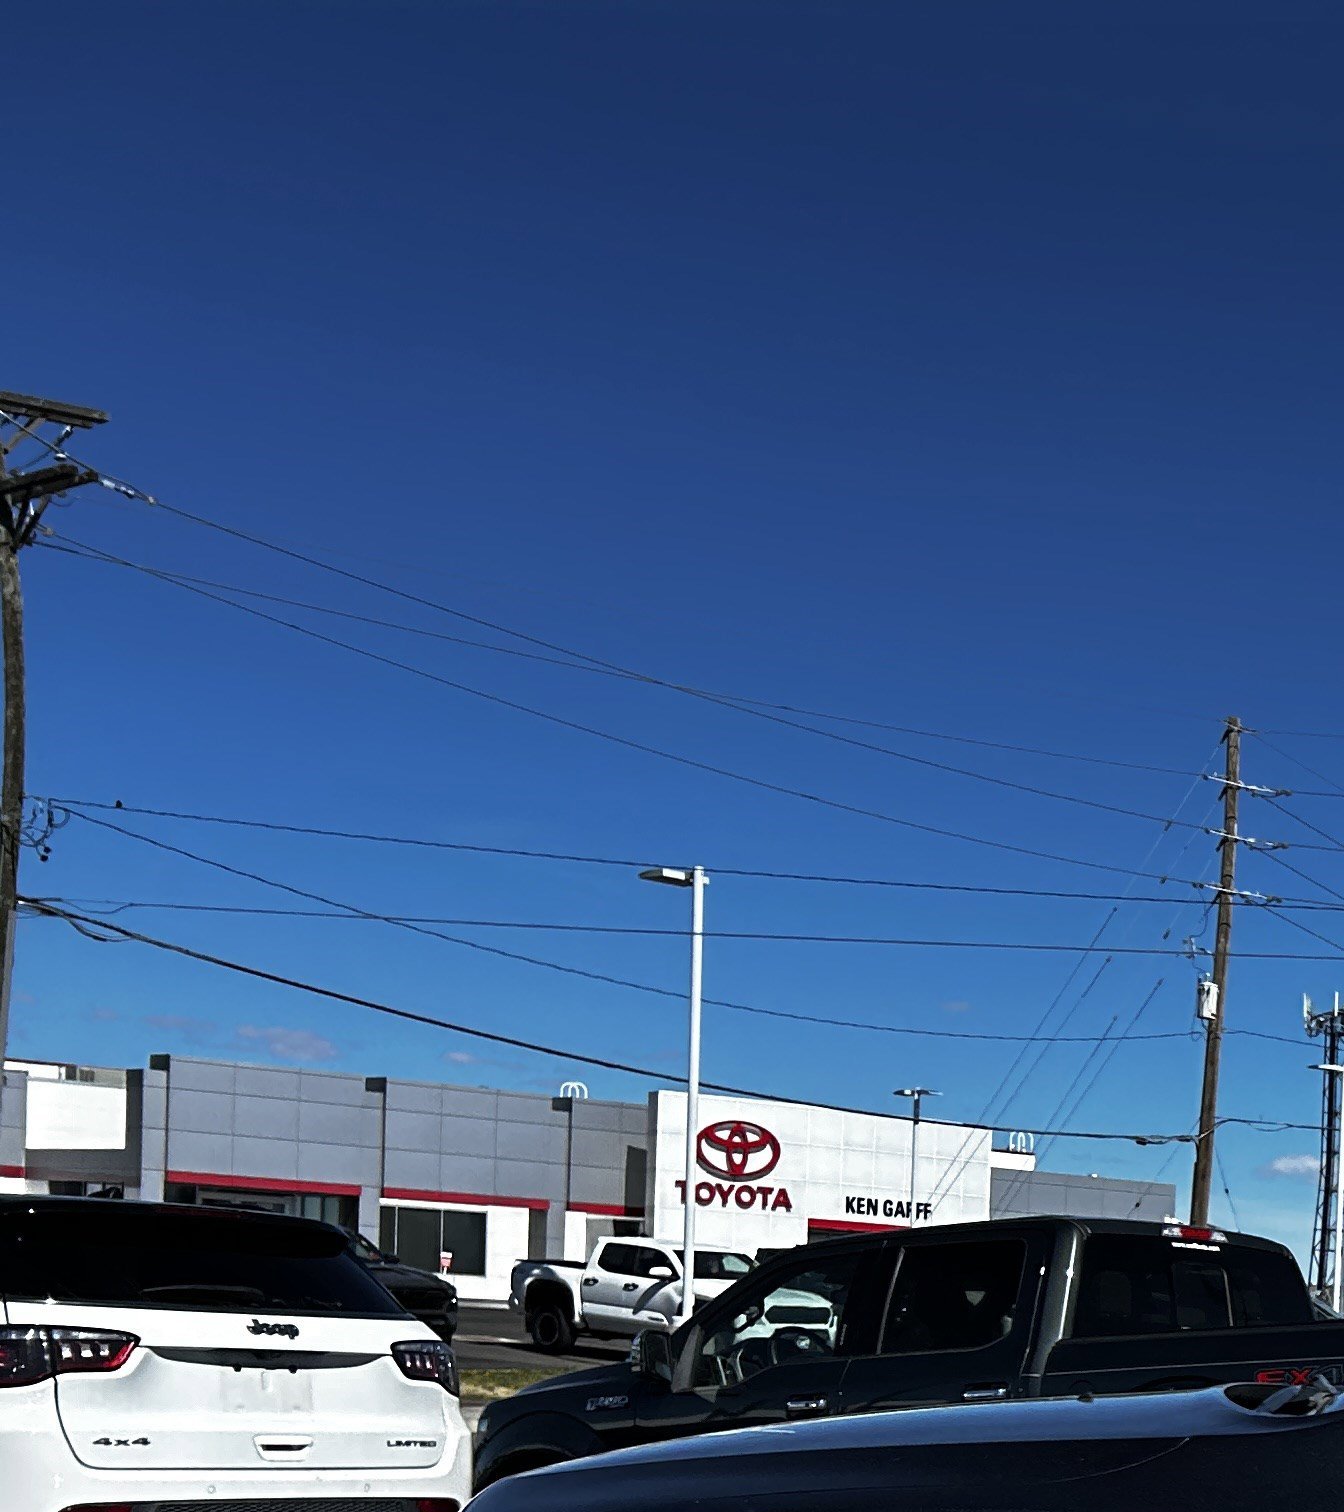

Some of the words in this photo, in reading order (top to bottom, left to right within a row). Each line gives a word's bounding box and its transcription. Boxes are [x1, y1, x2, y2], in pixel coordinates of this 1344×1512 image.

[675, 1180, 793, 1212] TOYOTA
[845, 1196, 878, 1216] KEN
[246, 1319, 299, 1340] Jeep
[387, 1440, 437, 1448] LIMITED
